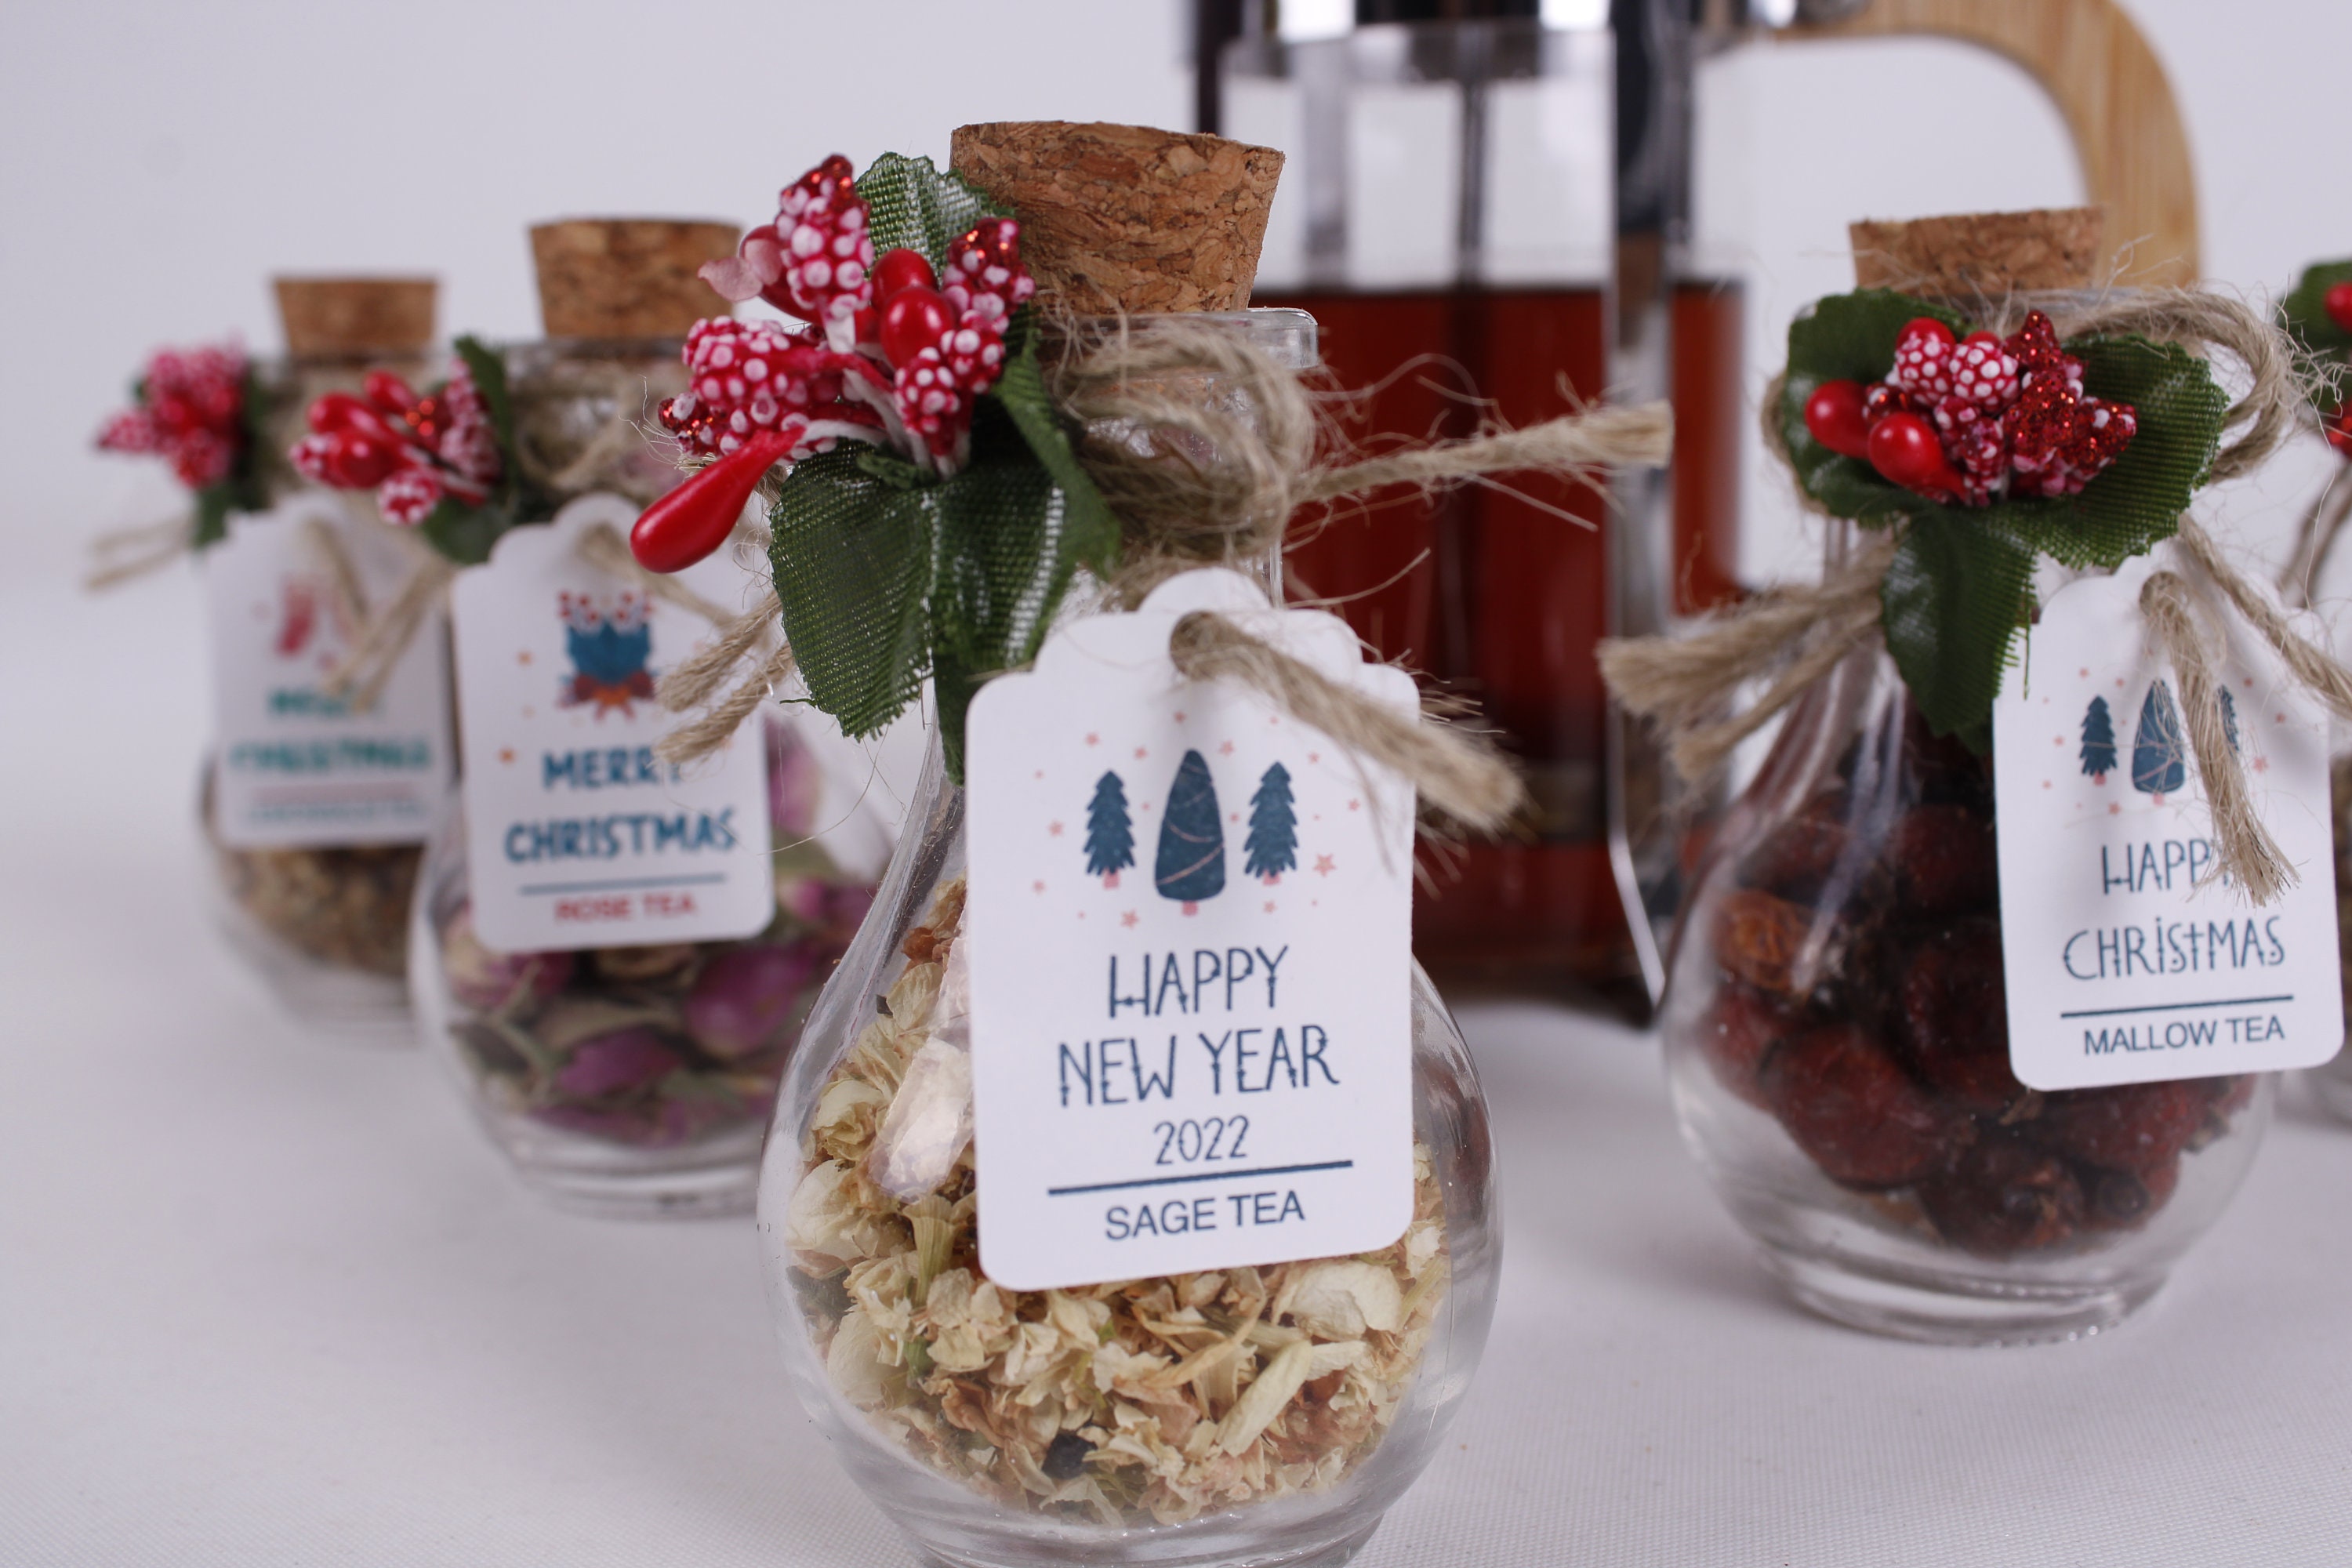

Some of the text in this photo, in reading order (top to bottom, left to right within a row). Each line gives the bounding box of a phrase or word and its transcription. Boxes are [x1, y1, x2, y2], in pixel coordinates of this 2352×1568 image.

[504, 805, 739, 864] CHRISTMAS
[554, 891, 697, 923] ROSE TEA
[1108, 944, 1289, 1018] HAPPY
[2084, 1015, 2285, 1055] MALLOW TEA
[1058, 1024, 1341, 1108] NEW YEAR
[1153, 1115, 1250, 1166] 2022
[1105, 1189, 1305, 1241] SAGE TEA
